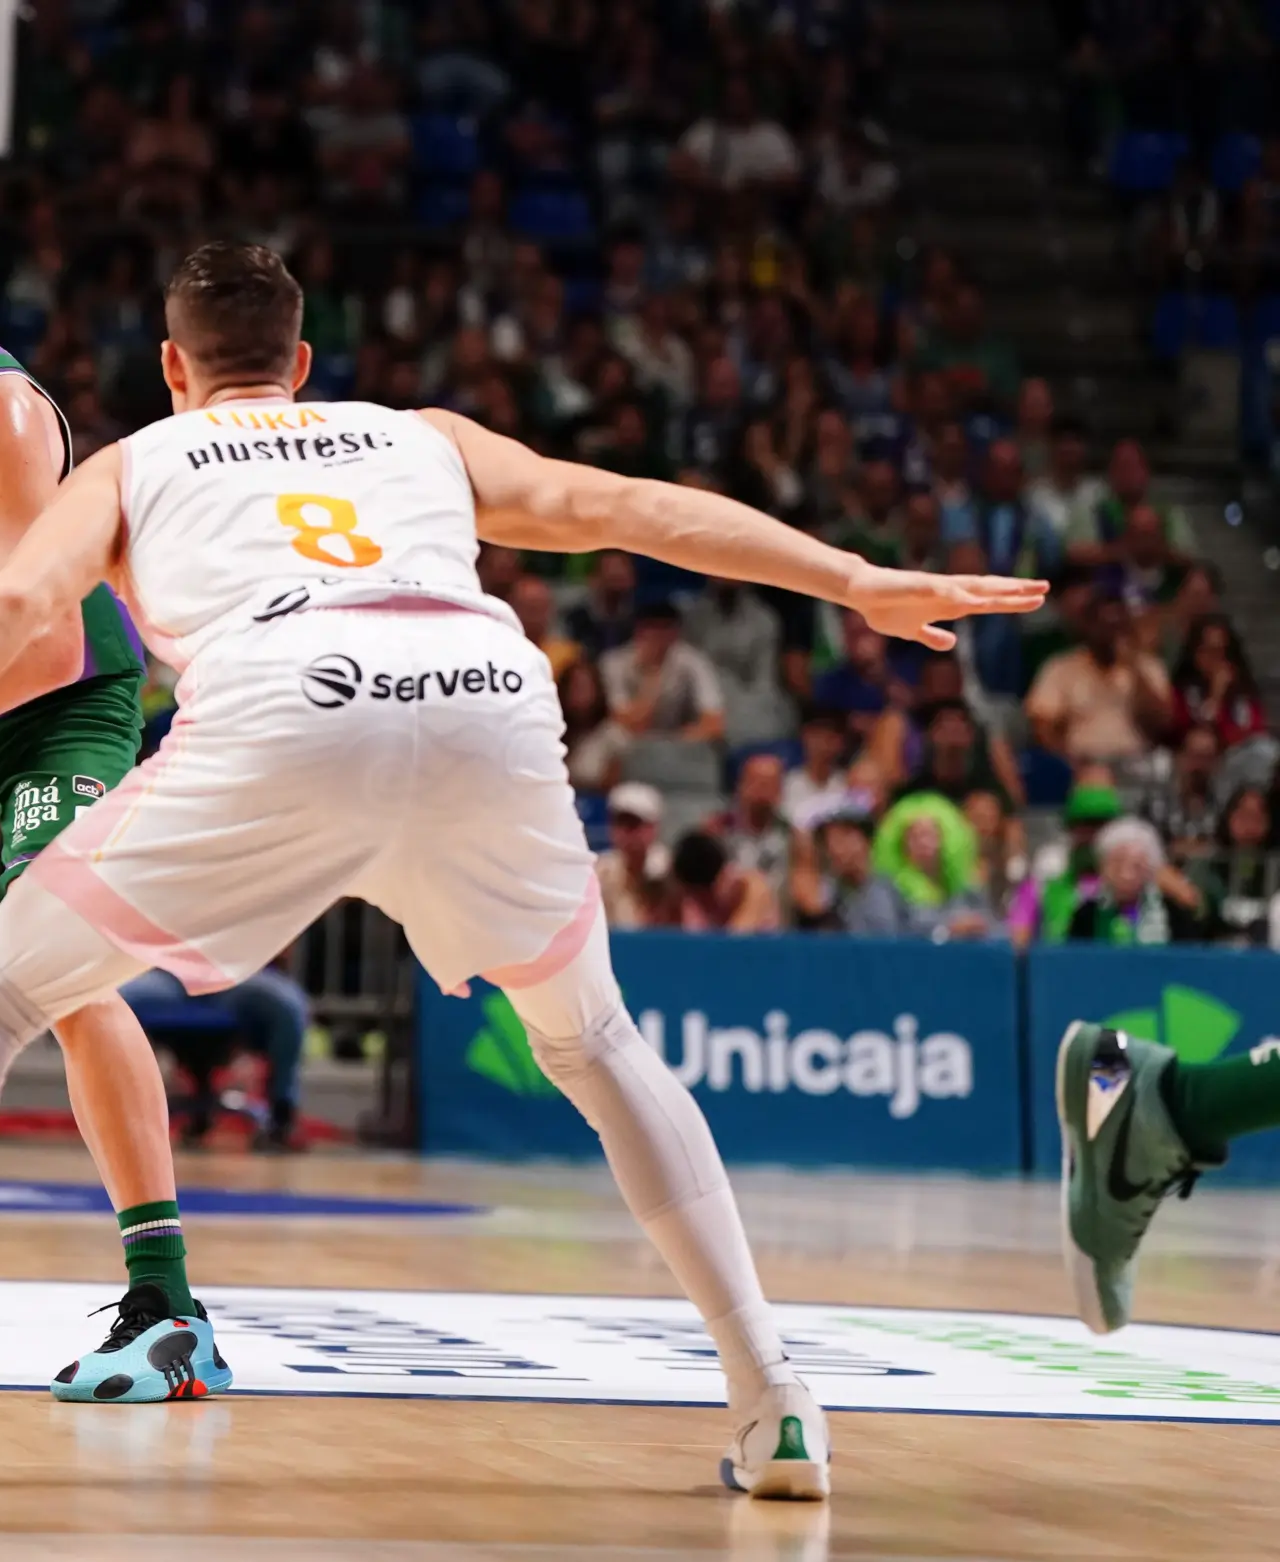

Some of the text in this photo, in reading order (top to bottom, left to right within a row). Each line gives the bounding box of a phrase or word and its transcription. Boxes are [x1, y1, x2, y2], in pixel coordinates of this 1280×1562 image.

[276, 493, 382, 568] 8
[370, 660, 523, 702] serveto
[76, 783, 100, 796] acb
[638, 1008, 974, 1120] Unicaja
